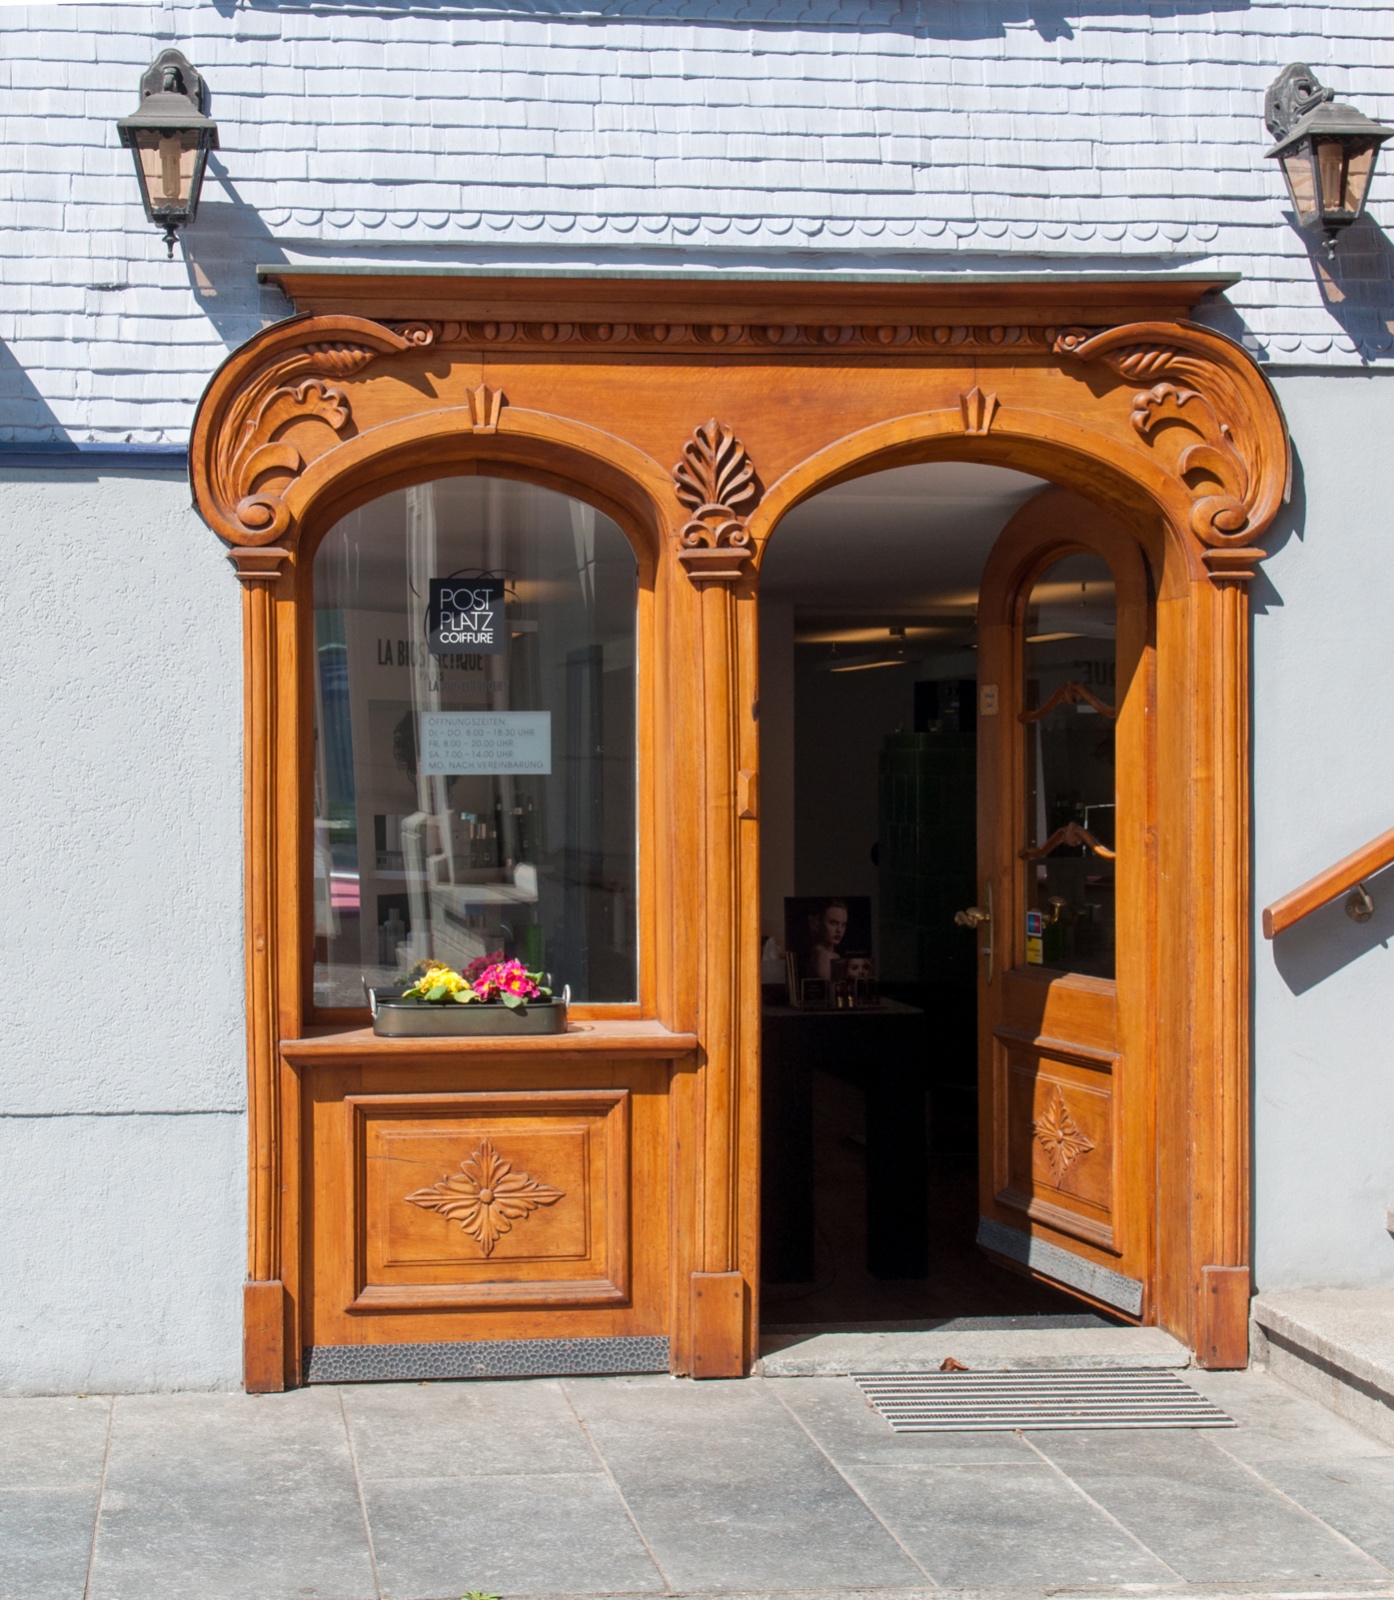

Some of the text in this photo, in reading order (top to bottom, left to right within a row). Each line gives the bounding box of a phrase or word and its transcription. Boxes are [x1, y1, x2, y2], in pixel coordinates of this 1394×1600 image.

[440, 588, 494, 611] POST
[440, 611, 494, 631] PLATZ
[439, 632, 494, 644] COIFFURE
[377, 638, 484, 671] LA BIOSETIQUE
[428, 680, 439, 692] LA
[428, 729, 438, 737] DI
[466, 729, 485, 737] 8.00
[493, 728, 516, 737] 18.30
[517, 728, 535, 736] UHR
[443, 740, 462, 748] 8.00
[471, 739, 495, 748] 20.00
[496, 739, 514, 747] UHR
[444, 750, 463, 758] 7.00
[471, 750, 495, 758] 14.00
[496, 750, 514, 758] UHR
[448, 761, 475, 769] NACH
[476, 760, 544, 769] VEREINBARUNG
